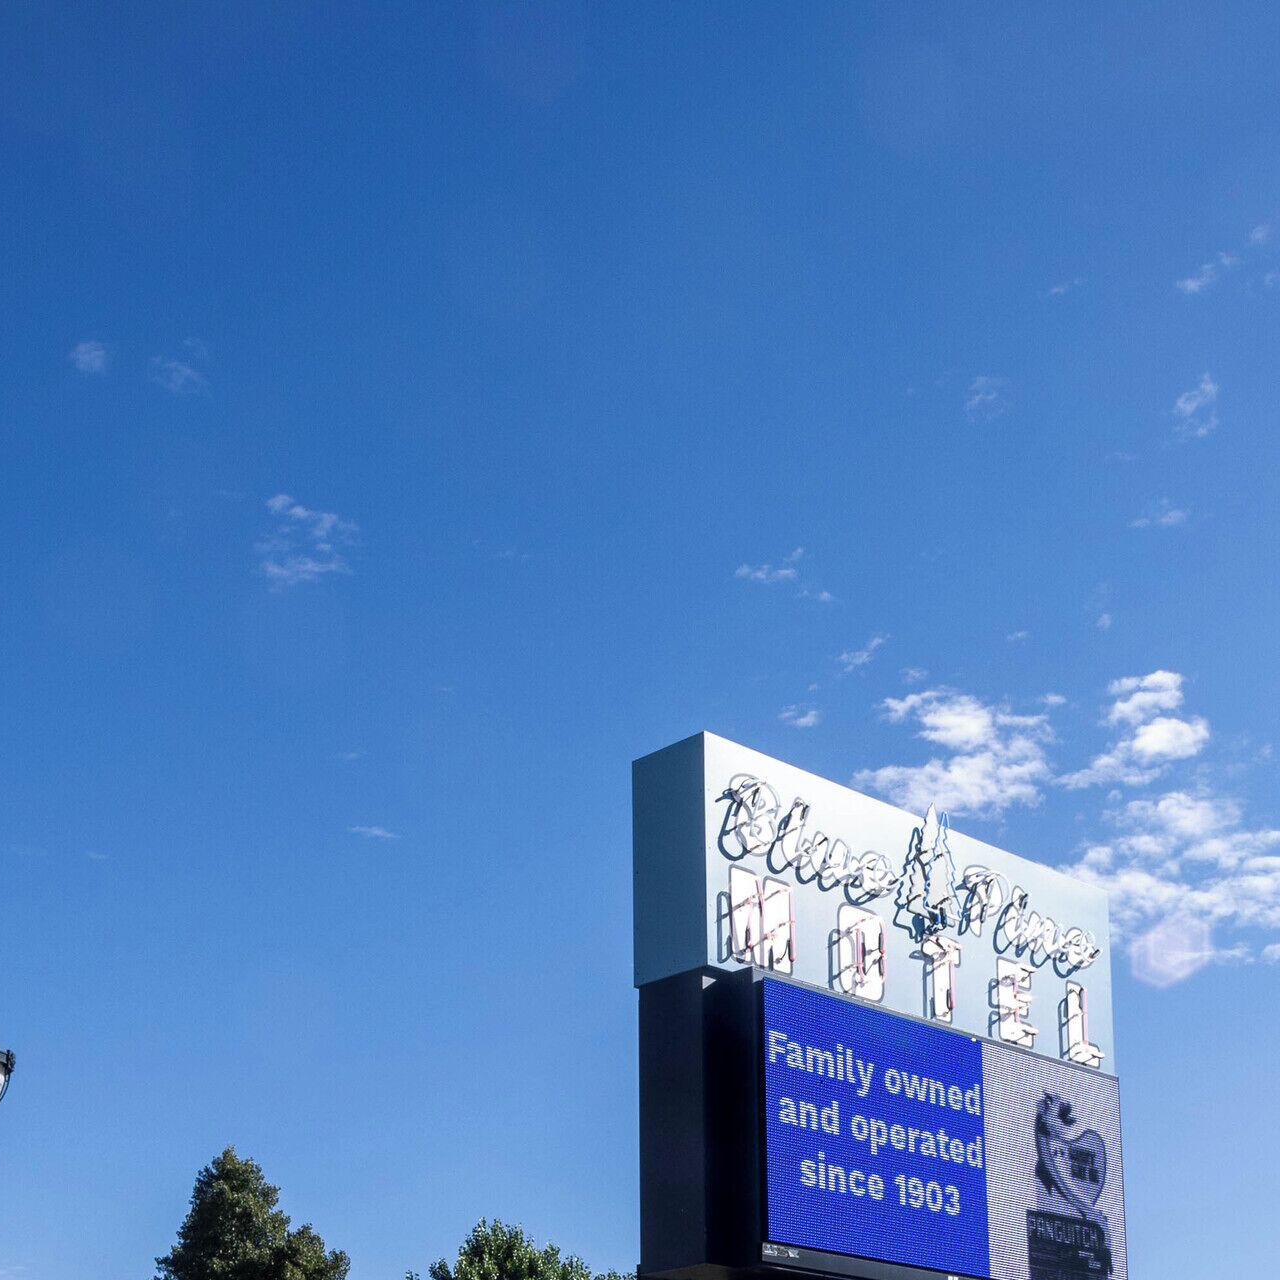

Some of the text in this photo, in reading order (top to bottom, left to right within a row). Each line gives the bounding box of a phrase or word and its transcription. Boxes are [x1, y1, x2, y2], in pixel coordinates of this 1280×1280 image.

[720, 773, 1101, 976] Blue Pine
[722, 864, 1105, 1069] MOTEL
[769, 1030, 982, 1116] Family owned
[778, 1096, 983, 1169] and operated
[800, 1151, 960, 1216] since 1903
